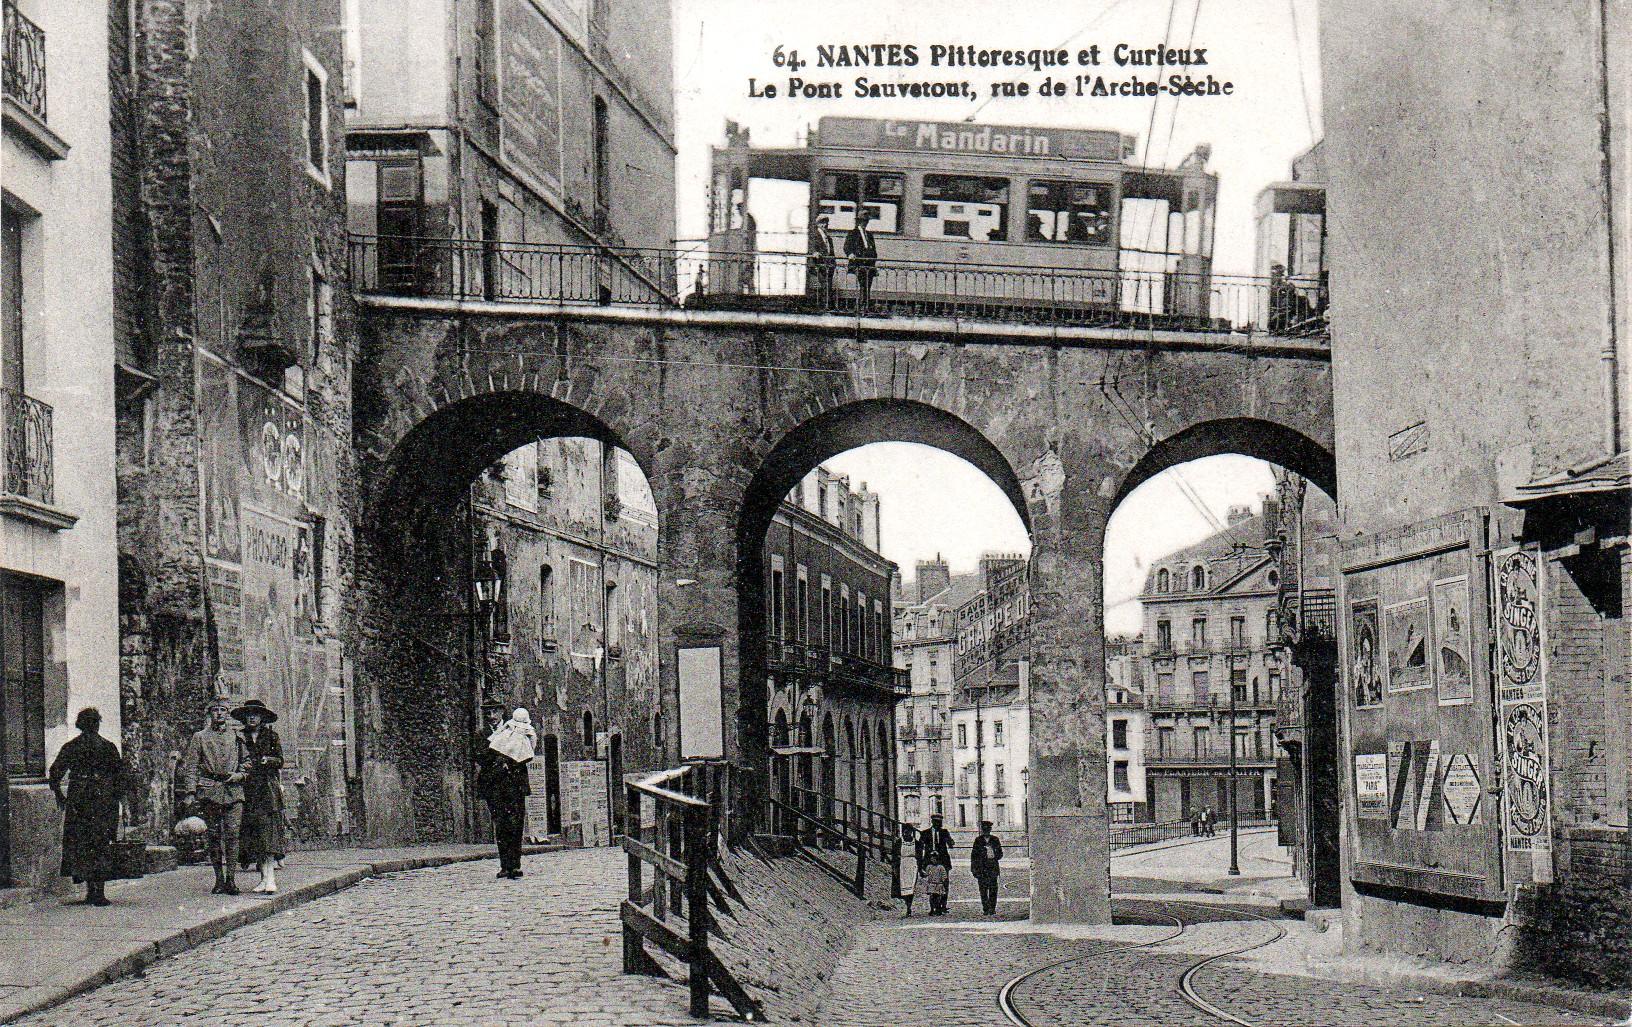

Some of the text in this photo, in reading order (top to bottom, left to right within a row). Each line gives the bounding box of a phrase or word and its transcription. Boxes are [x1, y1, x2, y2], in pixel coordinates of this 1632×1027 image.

[915, 123, 1050, 155] Mandarin
[960, 592, 993, 621] SAVON
[1504, 601, 1538, 637] SINGER
[958, 602, 1013, 656] GRAPPE
[1511, 751, 1545, 790] SINGER
